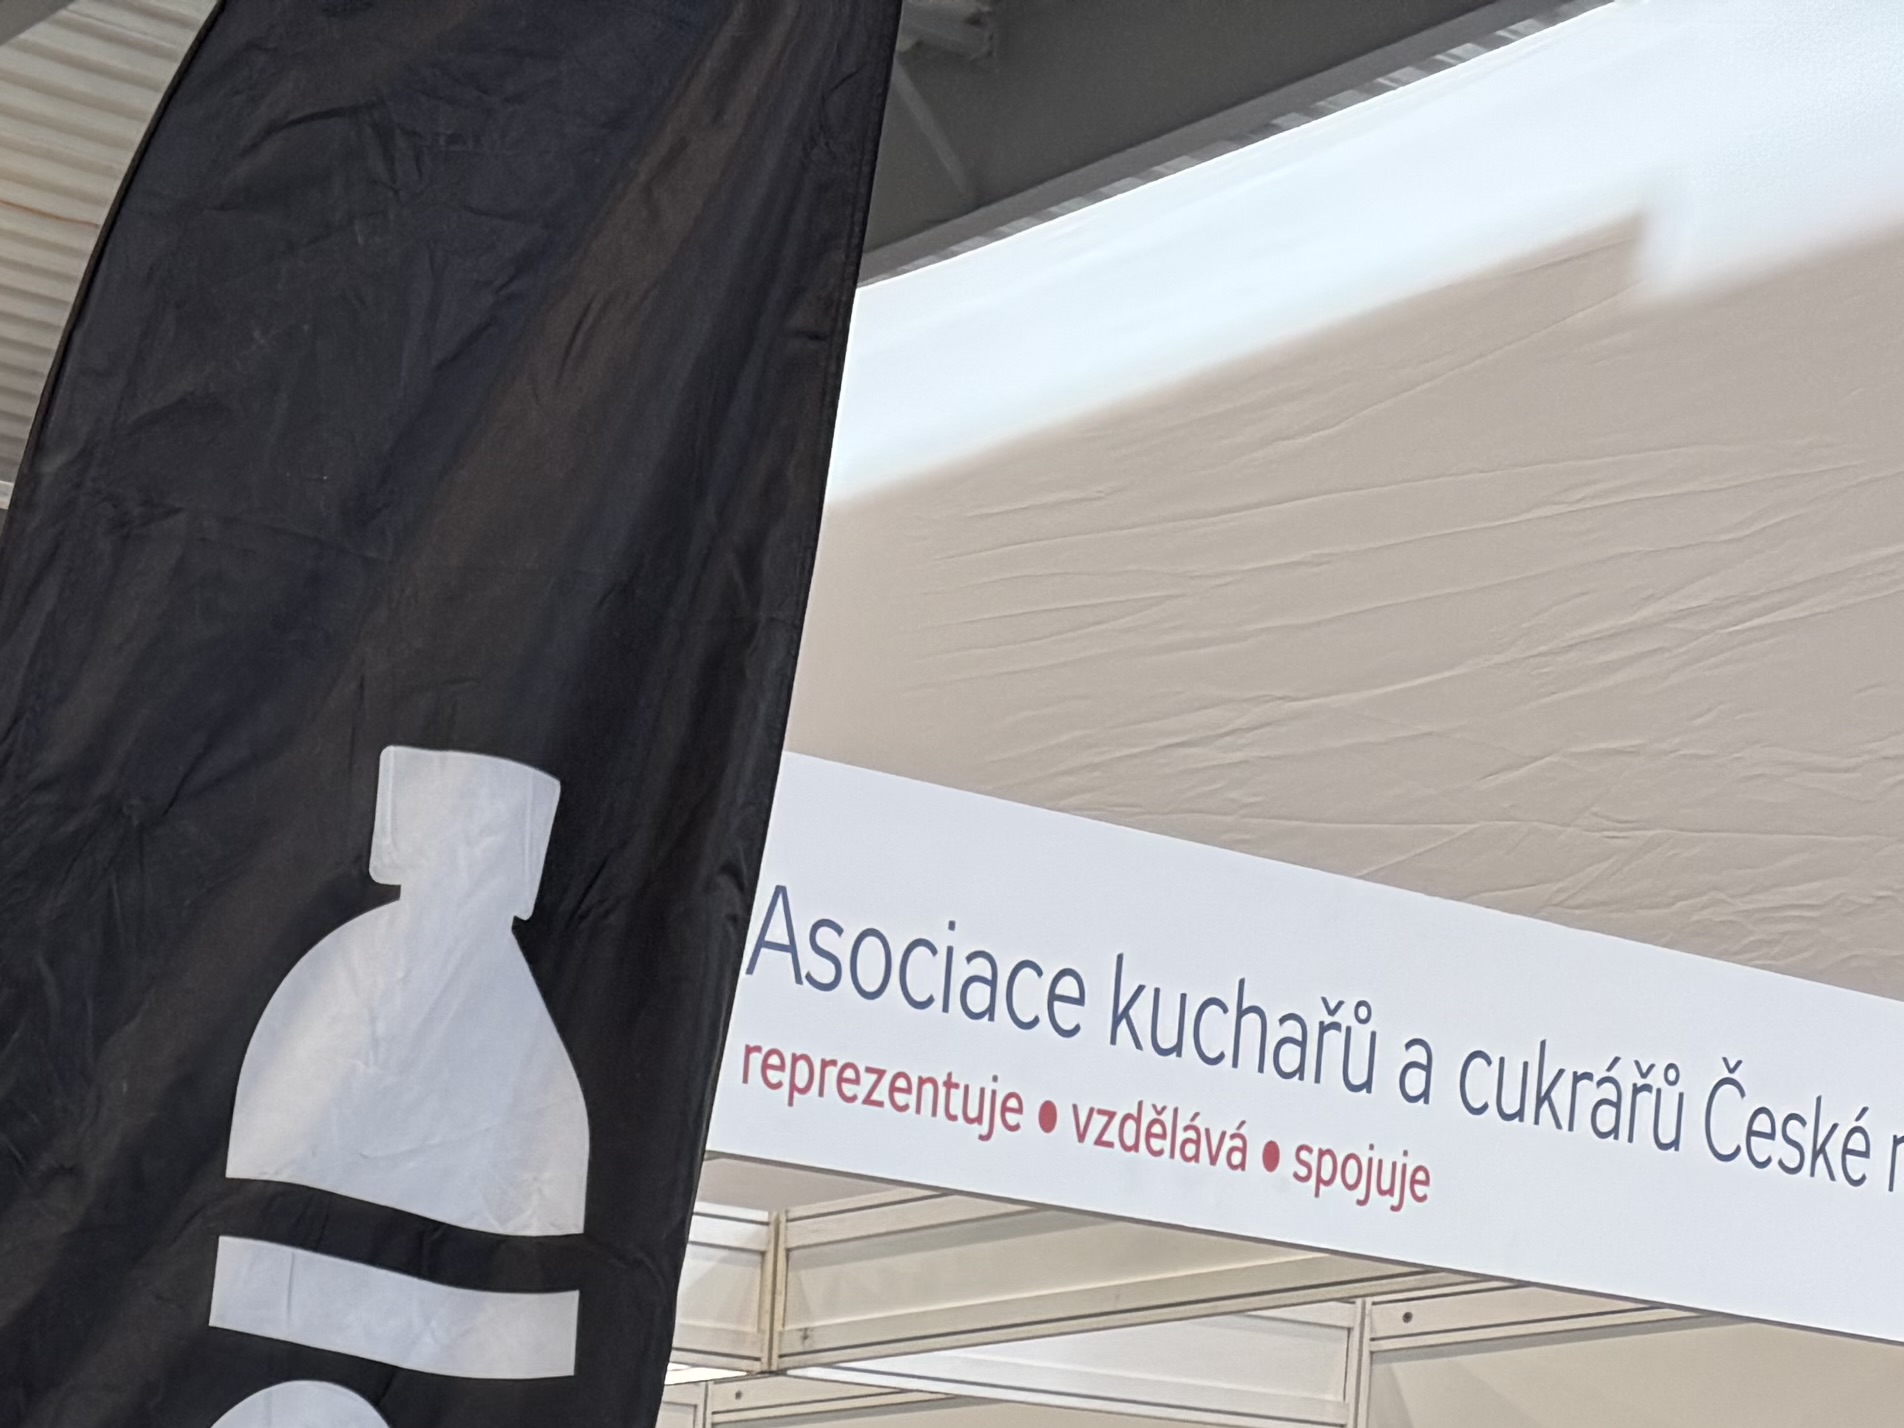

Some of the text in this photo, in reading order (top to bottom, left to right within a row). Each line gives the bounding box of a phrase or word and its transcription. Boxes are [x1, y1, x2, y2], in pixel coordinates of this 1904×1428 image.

[741, 1041, 1432, 1213] reprezentuje vzdělává spojuje
[745, 883, 1087, 1043] Asociace
[1109, 952, 1375, 1097] kuchařů
[1398, 1034, 1433, 1107] a
[1458, 1039, 1685, 1154] cukrářů
[1704, 1056, 1871, 1188] České
